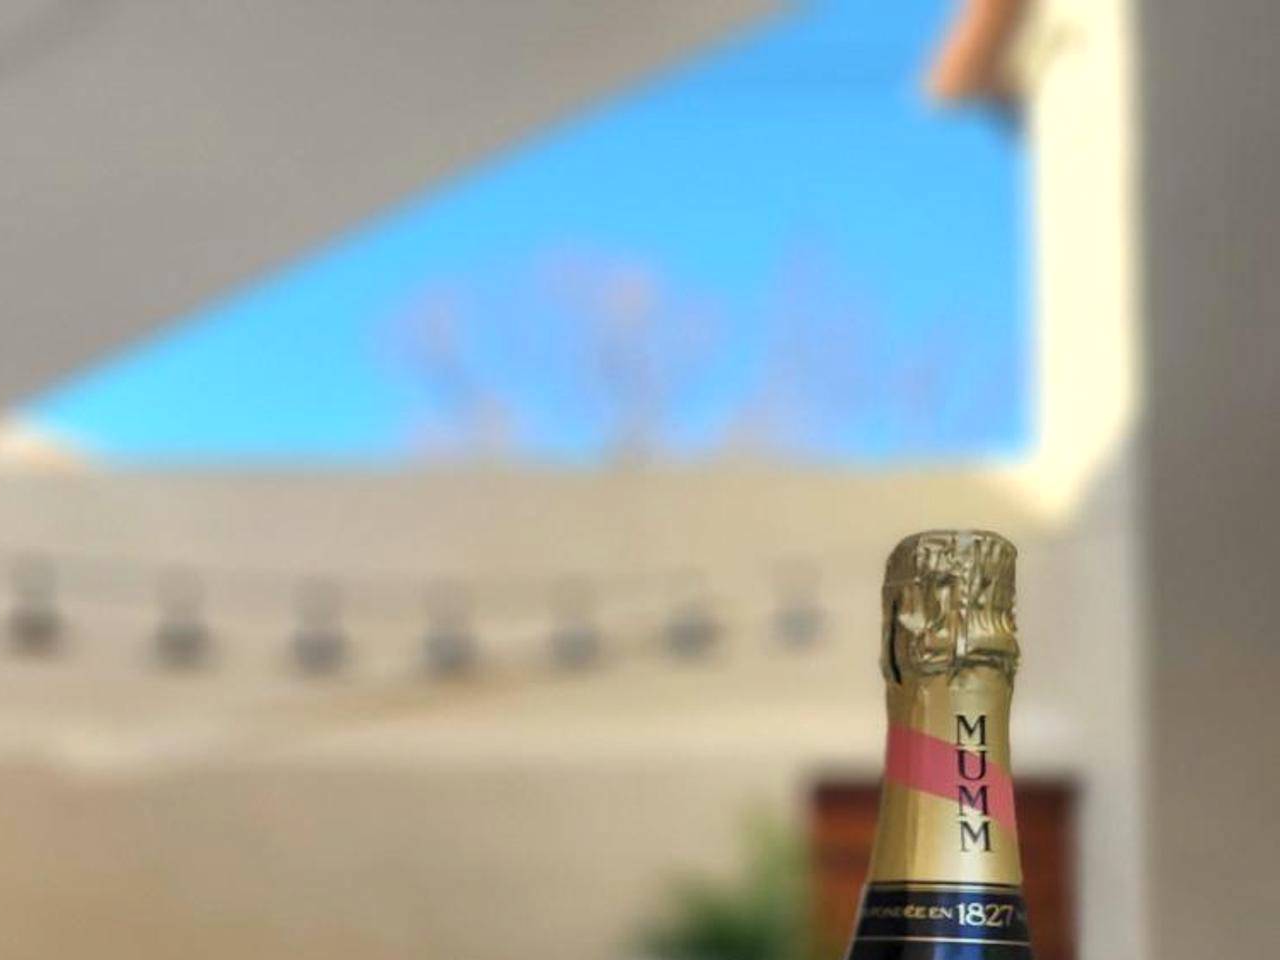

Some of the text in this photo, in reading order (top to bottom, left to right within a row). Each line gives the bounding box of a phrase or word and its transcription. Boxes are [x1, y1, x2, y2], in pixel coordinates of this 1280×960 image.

[956, 714, 992, 852] MUMM
[929, 906, 952, 919] EN
[956, 902, 1014, 927] 1827
